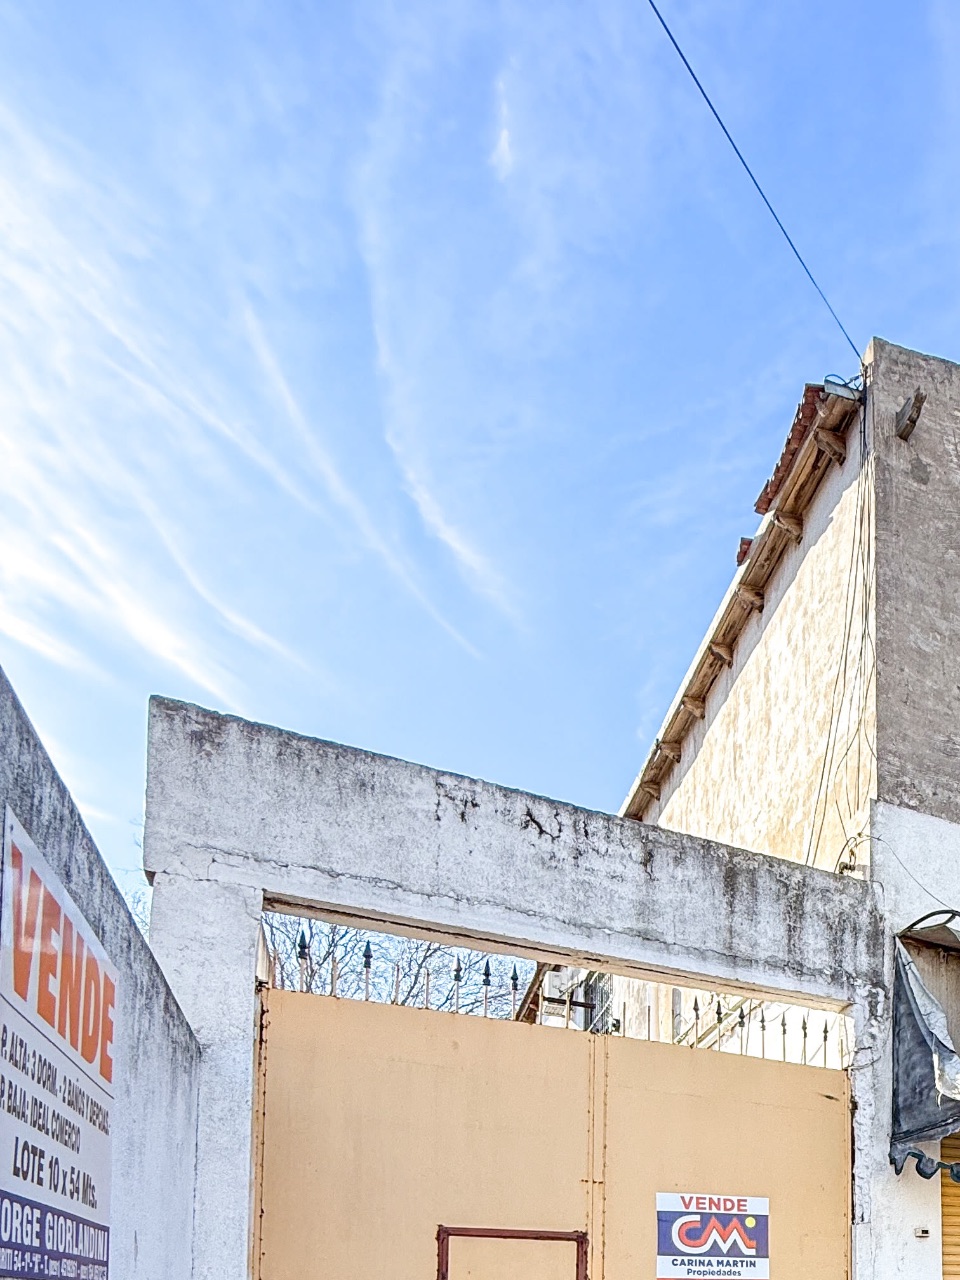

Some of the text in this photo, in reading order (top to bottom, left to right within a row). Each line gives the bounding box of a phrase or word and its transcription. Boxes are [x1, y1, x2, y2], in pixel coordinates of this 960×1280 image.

[11, 839, 115, 1084] VENDE
[9, 1032, 30, 1076] ALTA:
[31, 1049, 37, 1081] 3
[63, 1075, 67, 1104] 2
[7, 1080, 29, 1124] BAJA:
[30, 1095, 50, 1136] IDEAL
[51, 1109, 80, 1154] COMERCIO
[13, 1136, 45, 1187] LOTE
[49, 1155, 60, 1193] 10
[70, 1166, 80, 1201] 54
[0, 1195, 41, 1247] ORGE
[45, 1211, 108, 1262] GIORLANDINI
[680, 1195, 748, 1212] VENDE
[671, 1258, 757, 1268] CARINA MARTIN
[686, 1268, 742, 1277] Propiedades
